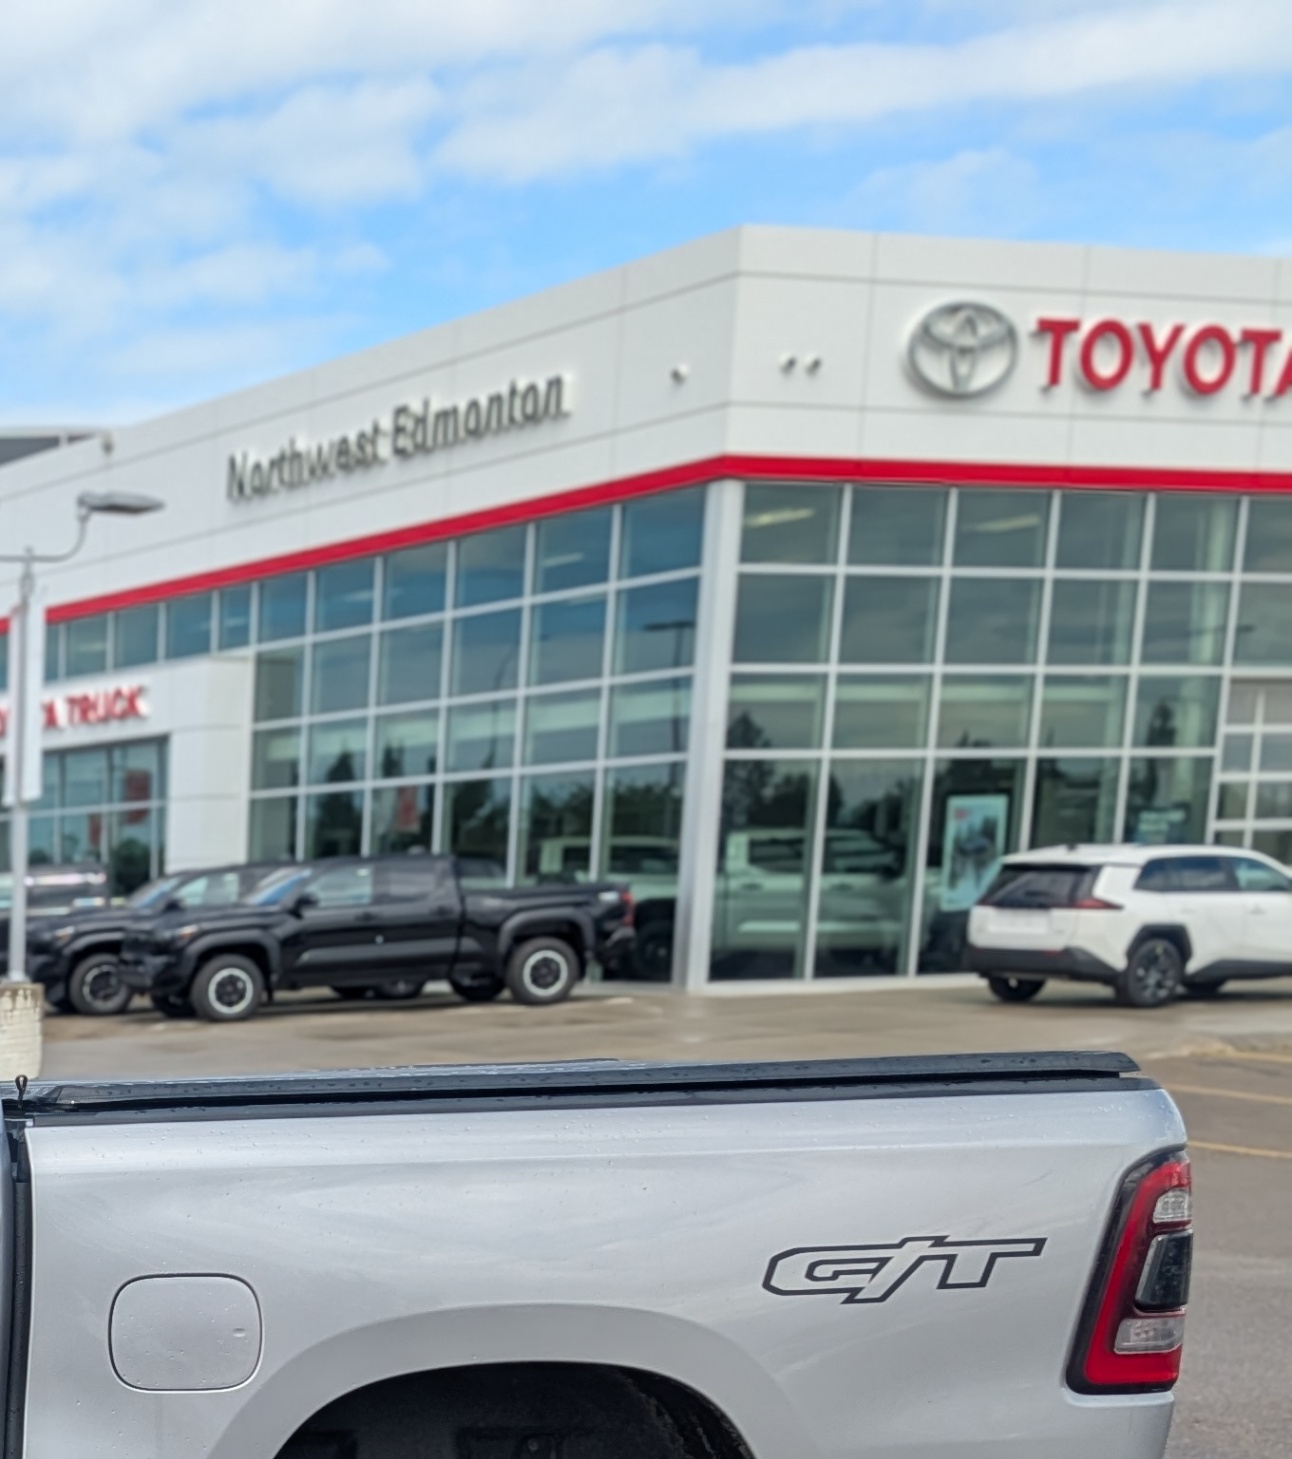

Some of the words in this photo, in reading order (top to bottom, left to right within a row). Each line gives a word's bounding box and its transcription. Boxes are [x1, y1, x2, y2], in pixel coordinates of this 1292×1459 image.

[227, 420, 384, 502] Northwest
[392, 375, 568, 456] Edmonton
[67, 686, 145, 728] TRUCK
